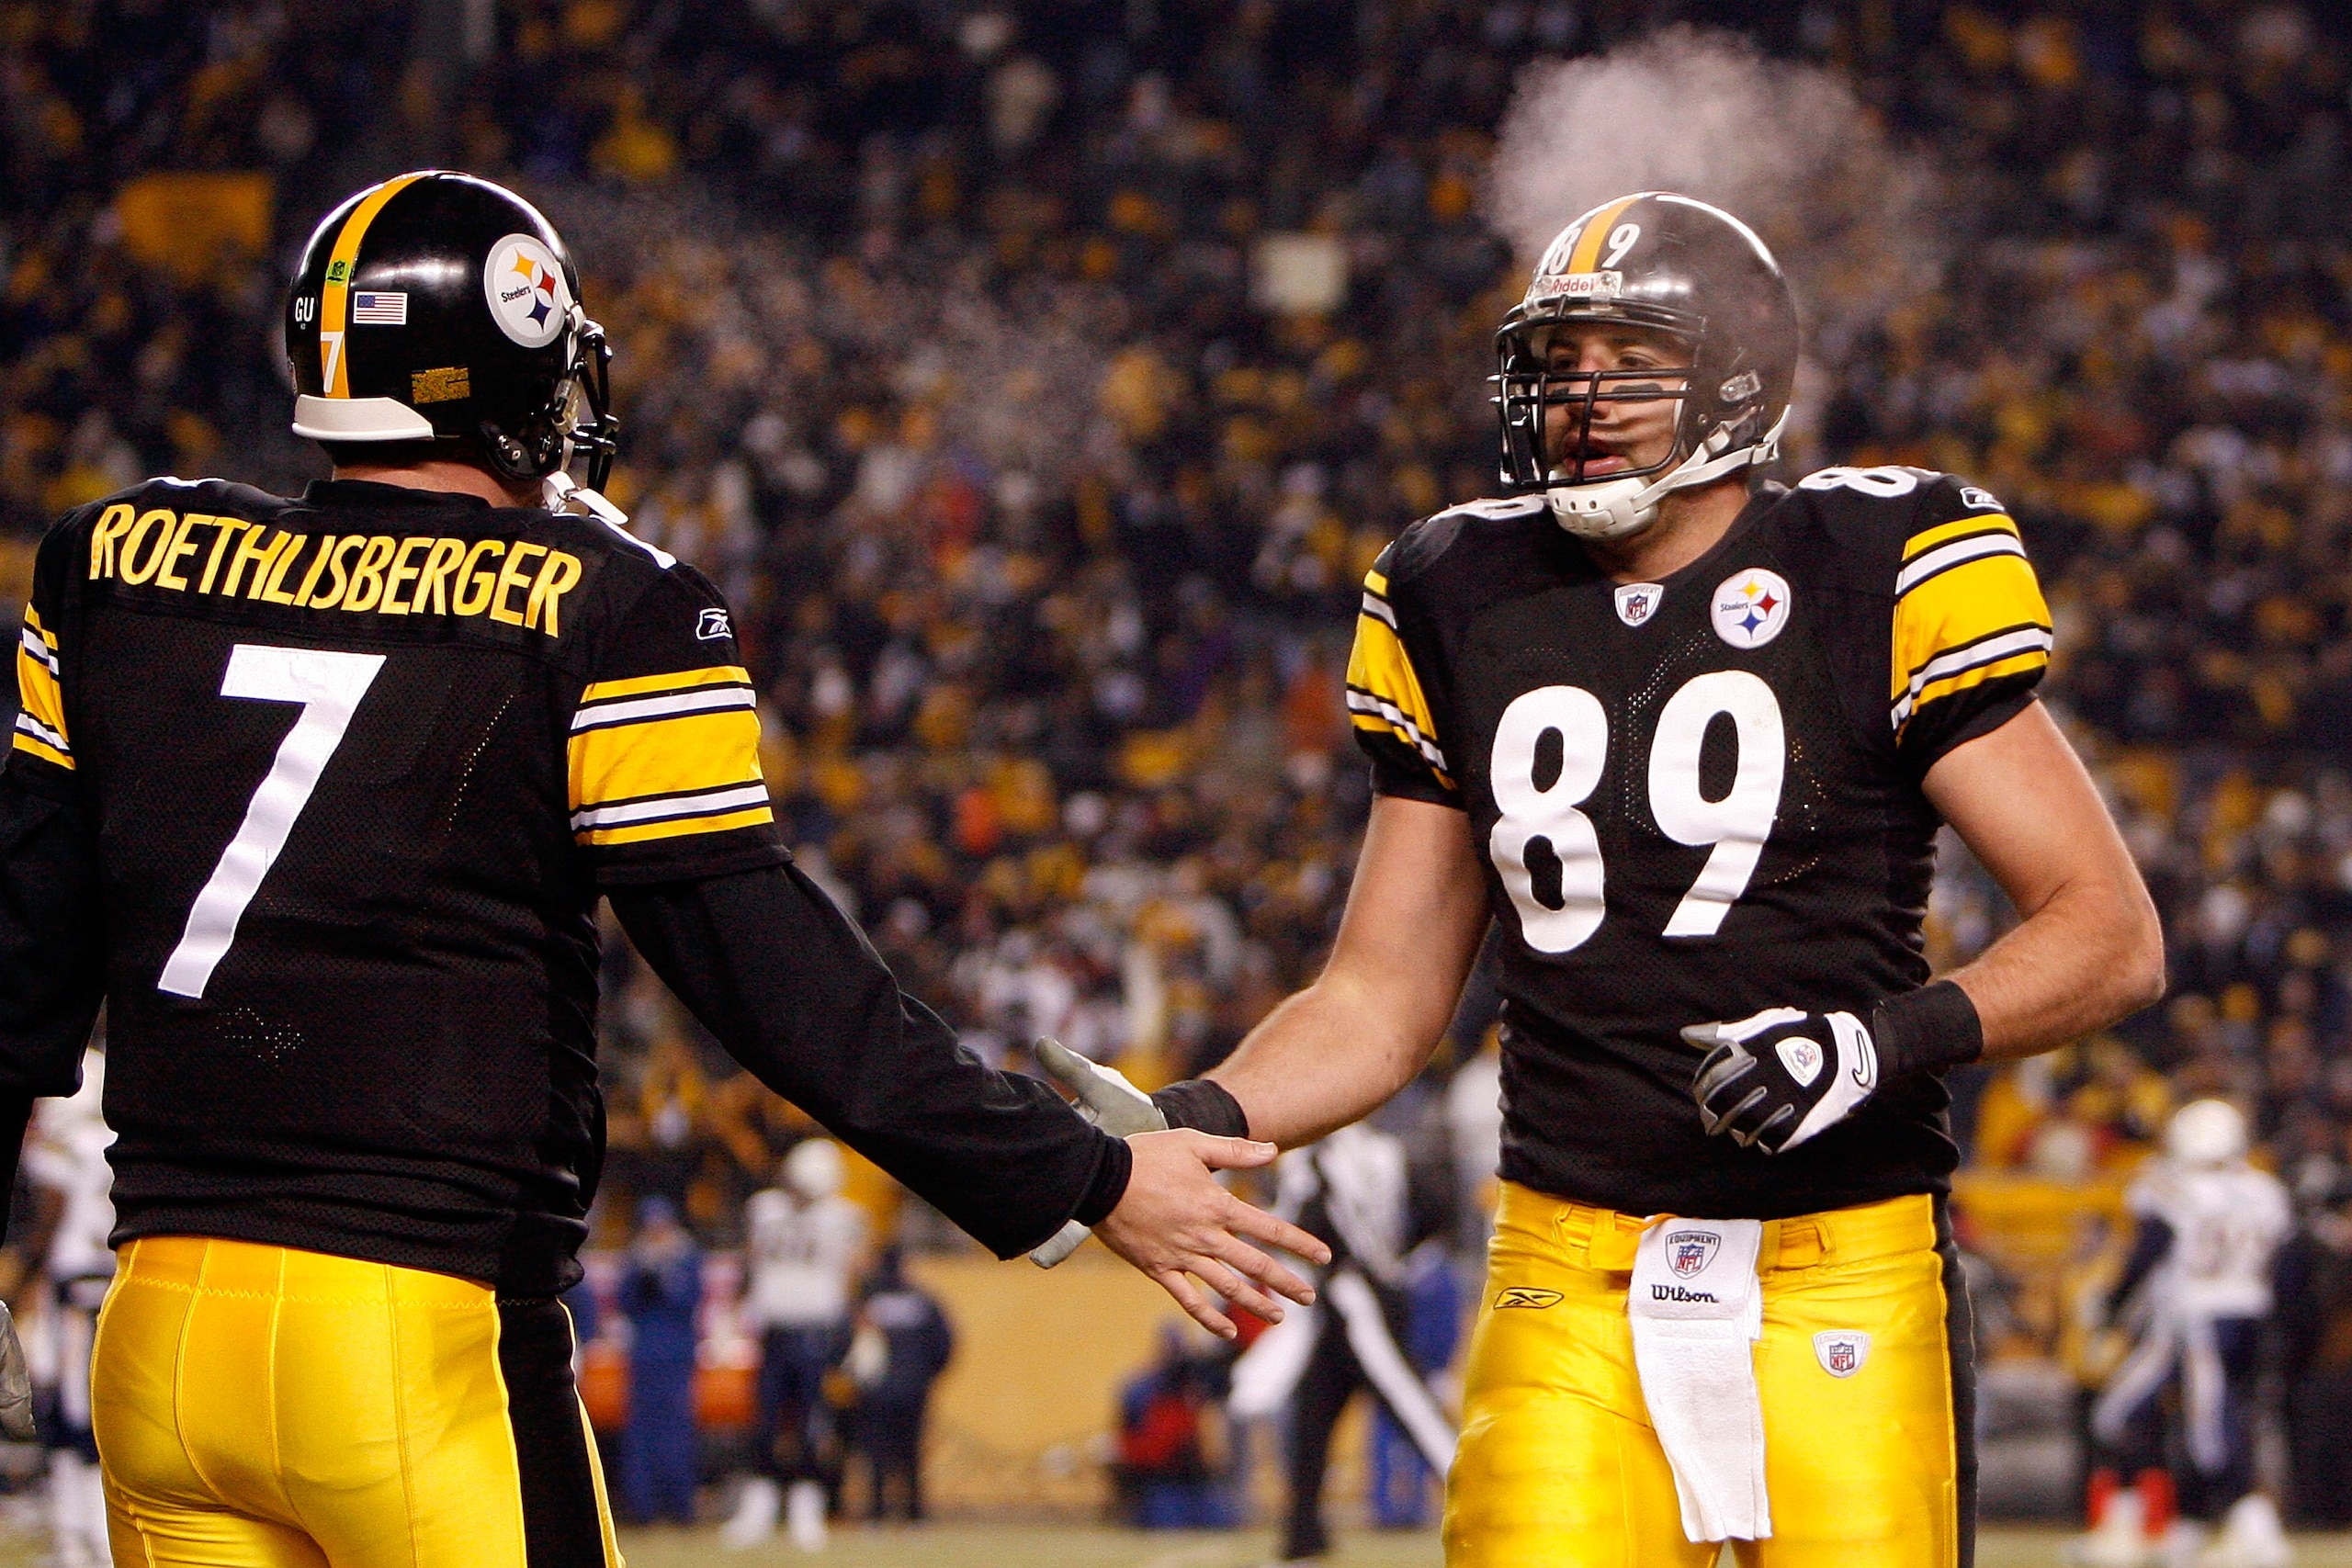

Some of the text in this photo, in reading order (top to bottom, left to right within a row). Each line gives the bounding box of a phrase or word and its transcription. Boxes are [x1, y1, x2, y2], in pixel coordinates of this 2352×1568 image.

[501, 286, 531, 303] Steelers
[1550, 277, 1596, 294] Riddel
[294, 297, 315, 322] GU
[320, 331, 346, 393] 7
[1798, 465, 1941, 498] 8
[89, 503, 582, 637] ROETHLISBERGER
[157, 643, 387, 999] 7
[1490, 669, 1787, 953] 89
[1668, 1234, 1717, 1246] EQUIPMENT
[1677, 1256, 1702, 1272] NFL
[1650, 1283, 1720, 1303] Wilson
[1831, 1353, 1854, 1370] NFL
